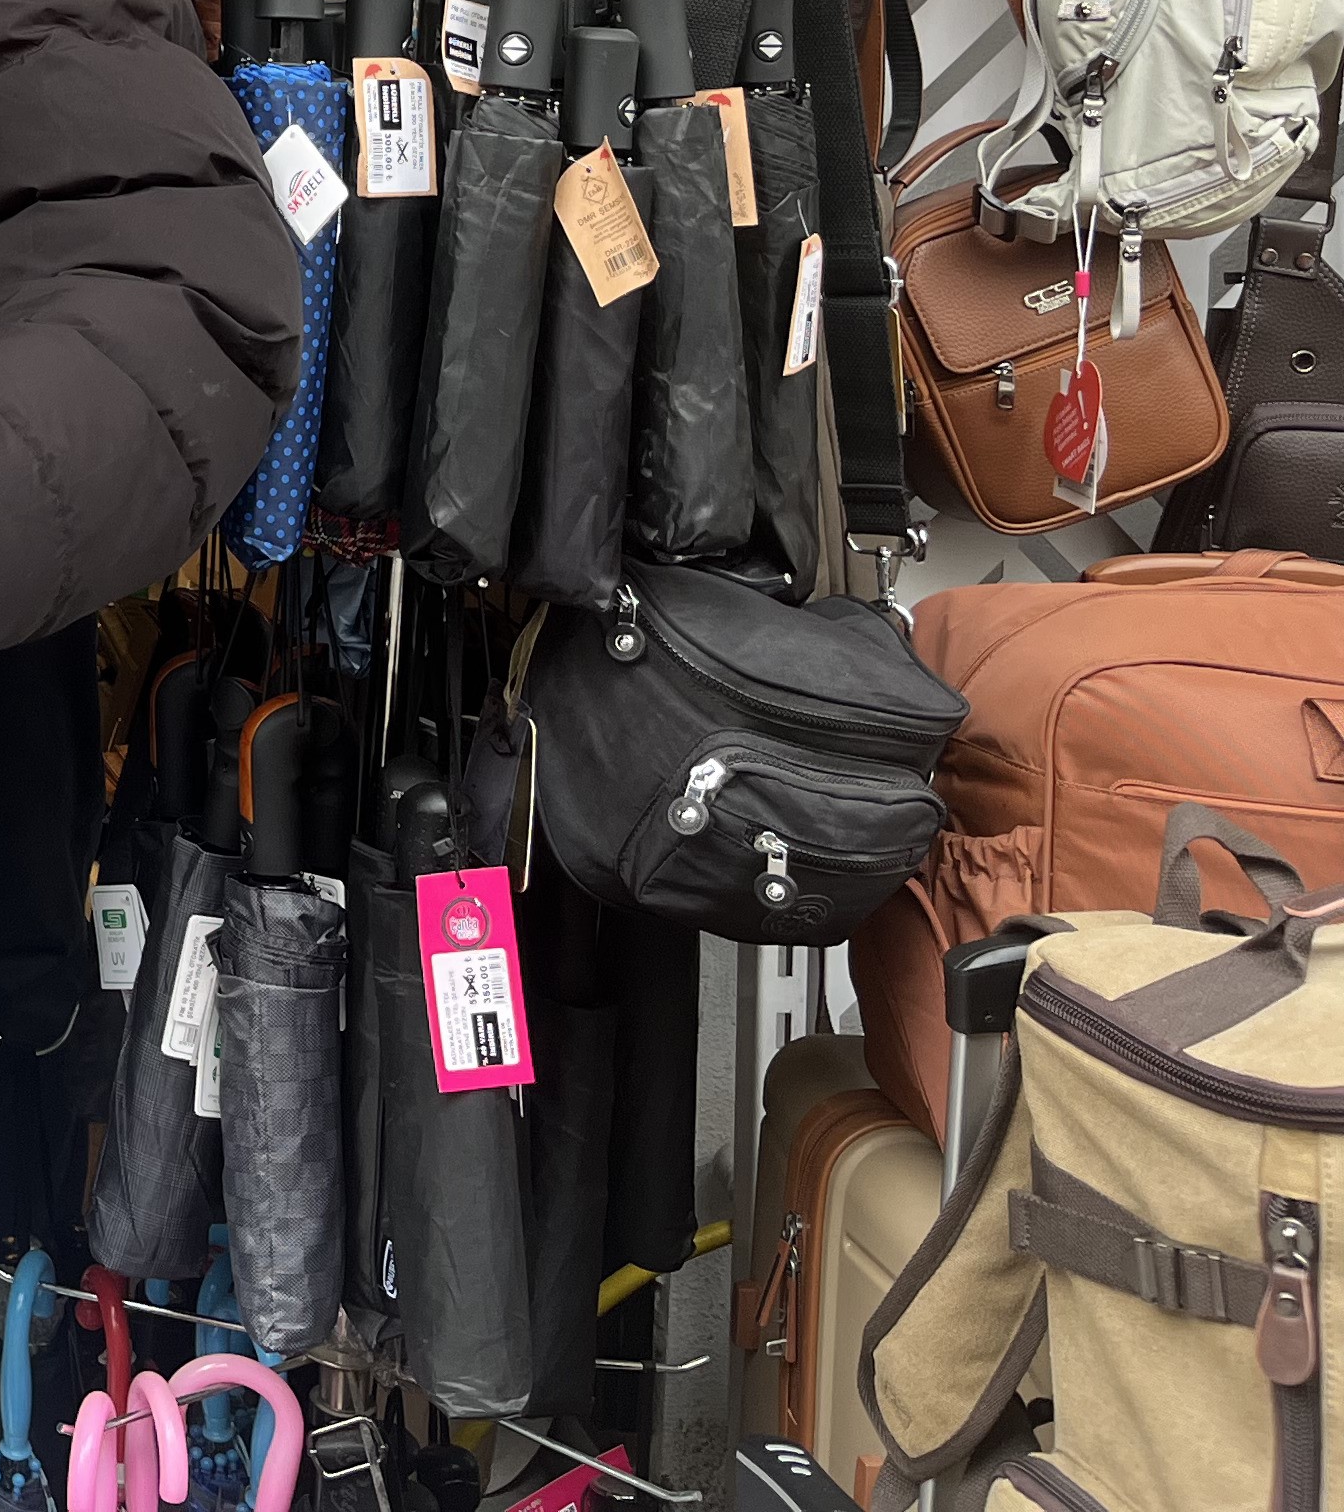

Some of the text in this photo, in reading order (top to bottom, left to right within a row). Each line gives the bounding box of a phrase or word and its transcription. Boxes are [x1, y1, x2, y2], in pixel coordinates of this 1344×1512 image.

[286, 168, 327, 215] SKYBELT
[577, 211, 597, 227] DMR
[1023, 280, 1075, 308] CCS
[110, 951, 126, 966] UV
[480, 966, 491, 1003] 350,00
